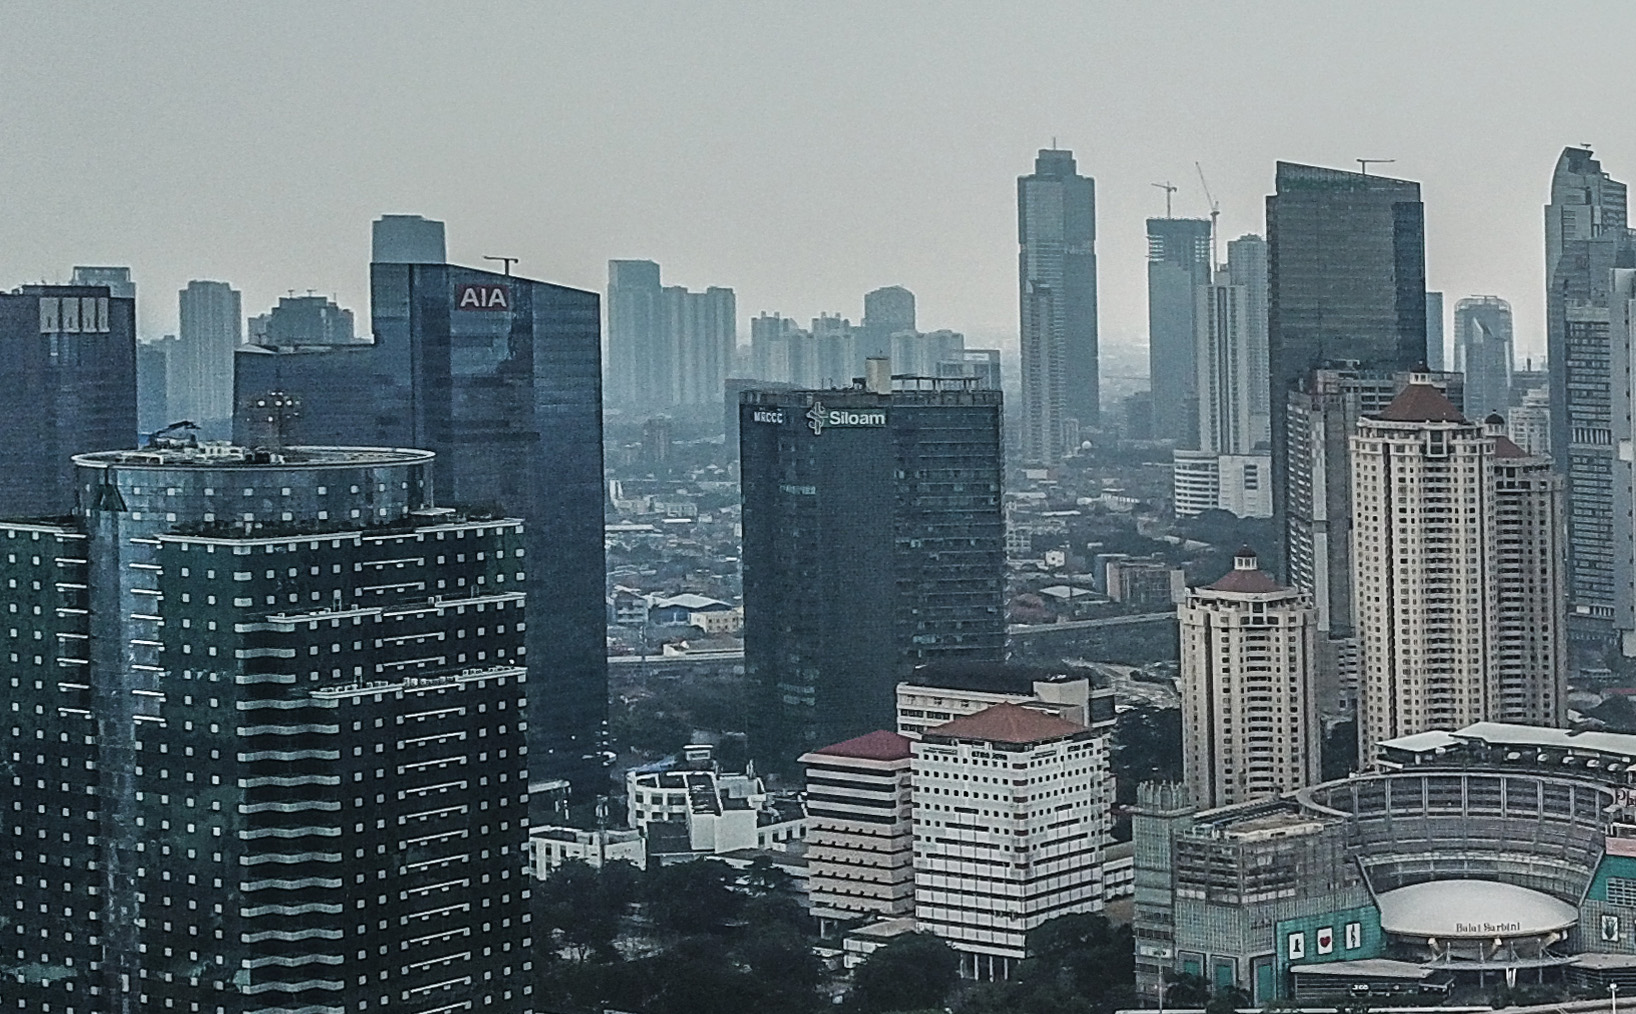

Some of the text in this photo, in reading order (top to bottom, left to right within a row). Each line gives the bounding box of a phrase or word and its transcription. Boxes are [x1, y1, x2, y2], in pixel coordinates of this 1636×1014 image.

[460, 287, 507, 307] AIA
[829, 411, 886, 425] Siloam
[1456, 922, 1481, 933] Balai
